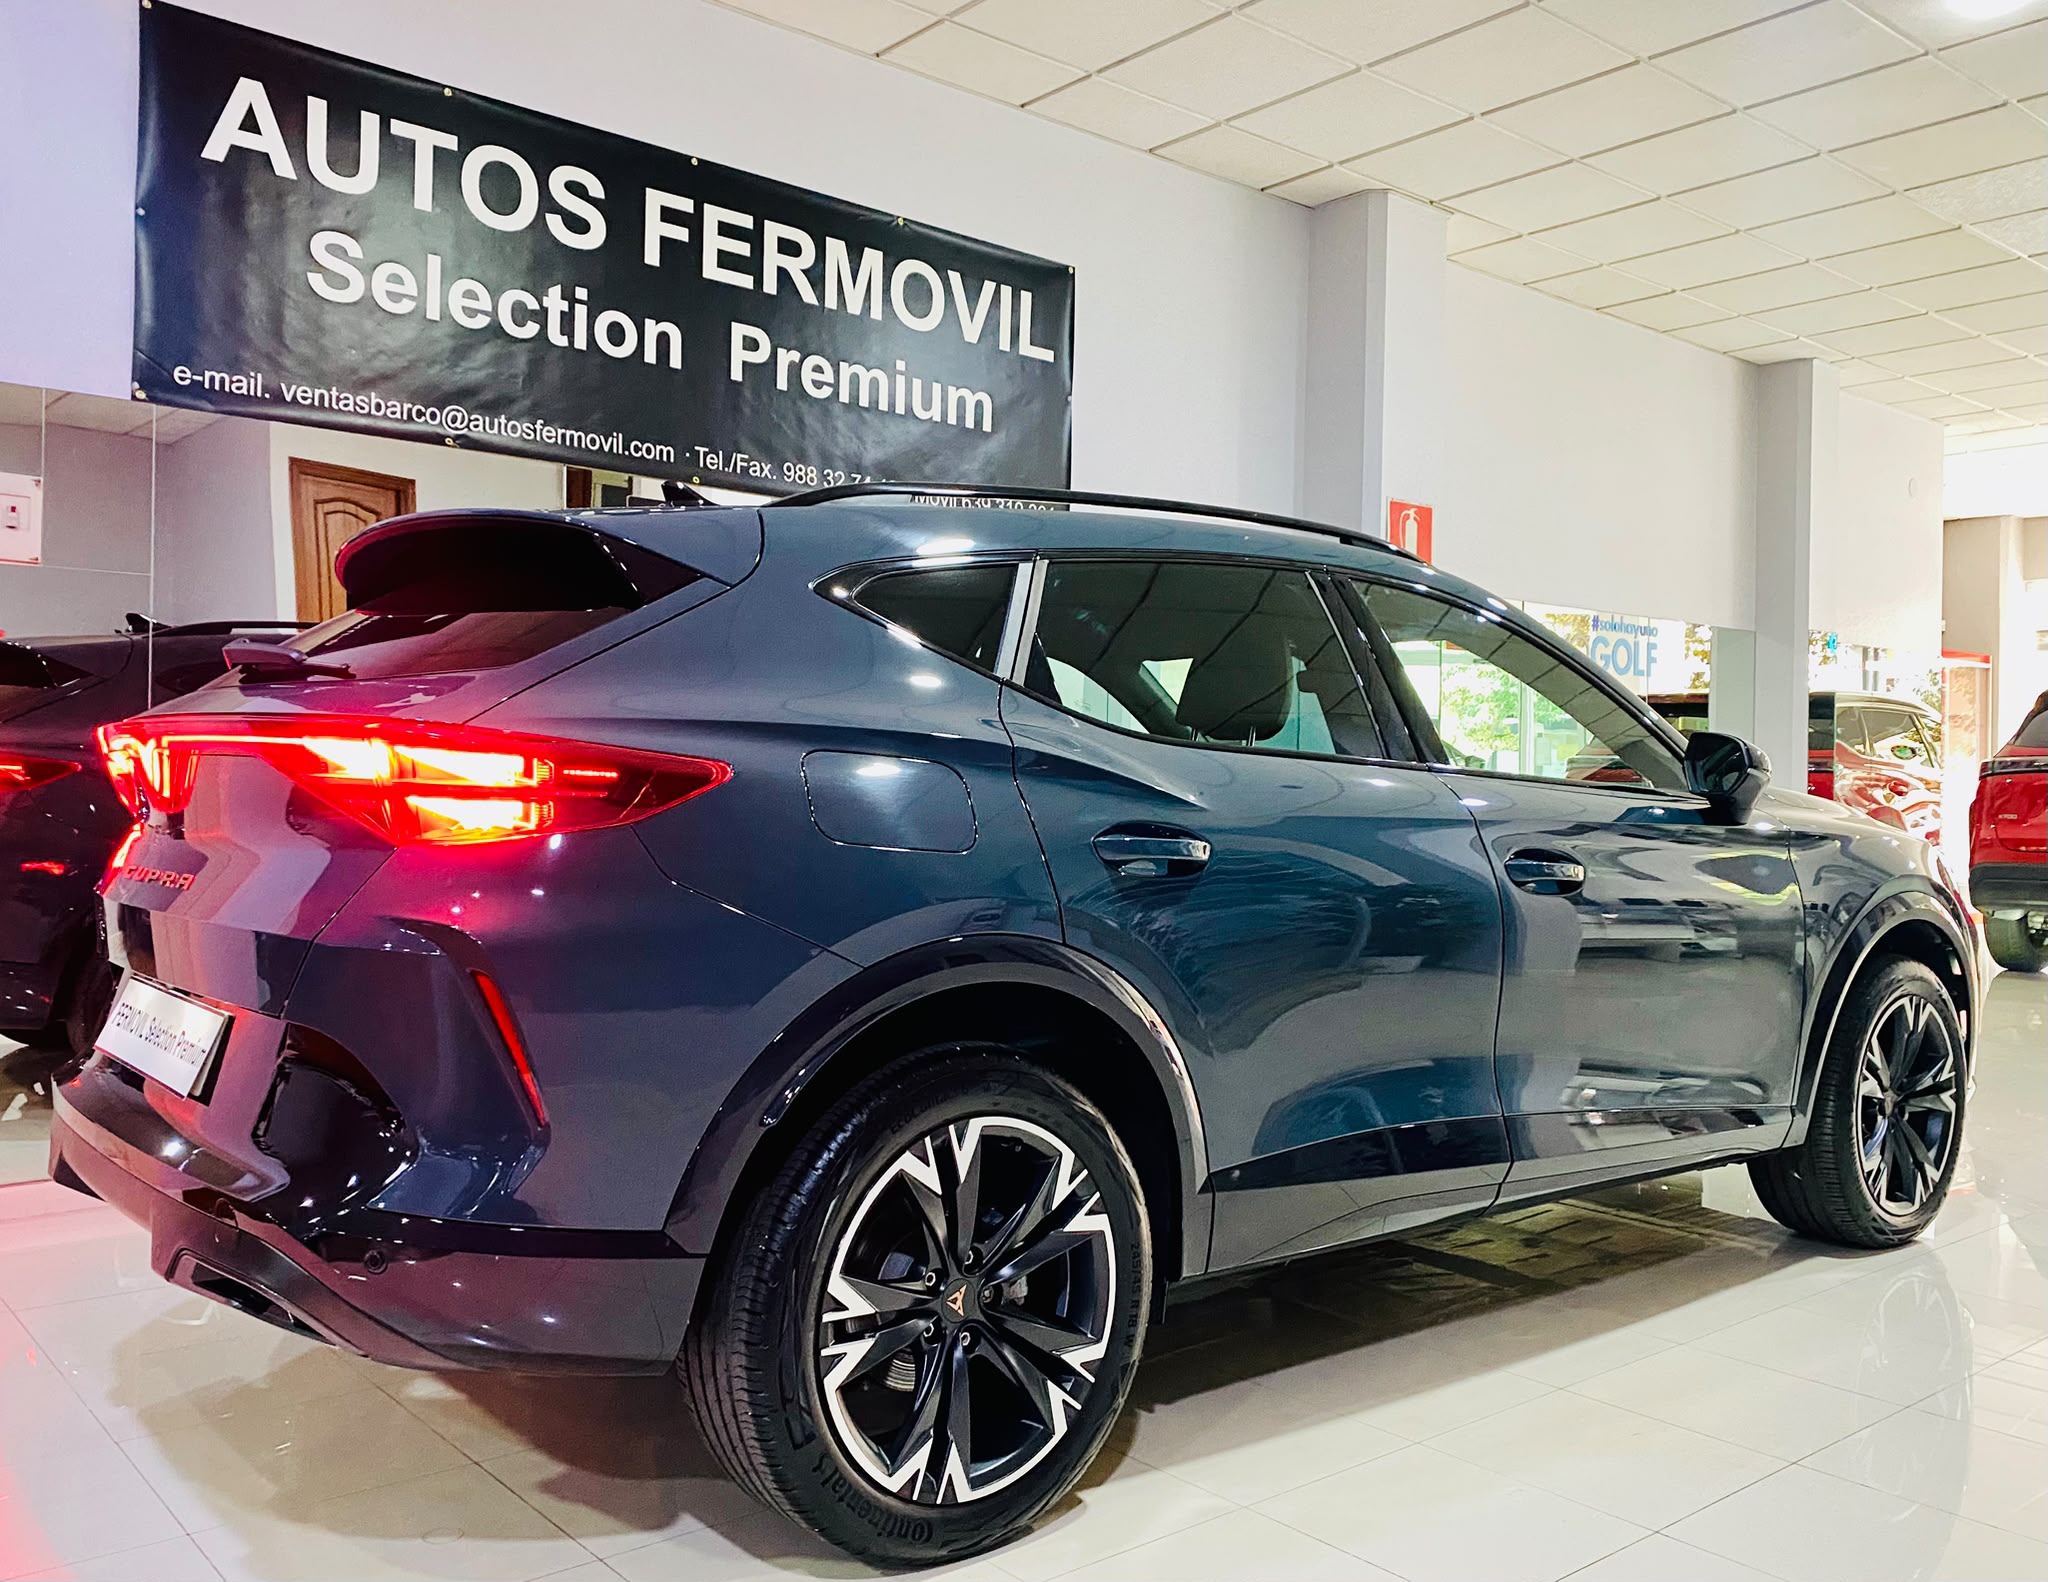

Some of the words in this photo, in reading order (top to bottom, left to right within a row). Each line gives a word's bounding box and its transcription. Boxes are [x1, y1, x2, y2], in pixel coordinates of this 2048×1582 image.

[201, 76, 607, 250] AUTOS
[644, 187, 1055, 363] FERMOVIL
[306, 230, 682, 370] Selection
[730, 321, 993, 432] Premium
[173, 365, 270, 399] e-mail.
[281, 382, 674, 463] ventasbarco@autosfermovil.com
[694, 446, 777, 480] Tel./Fax.
[783, 462, 817, 486] 988
[823, 469, 845, 488] 32
[1591, 635, 1658, 677] GOLF
[122, 865, 196, 891] CUPRA
